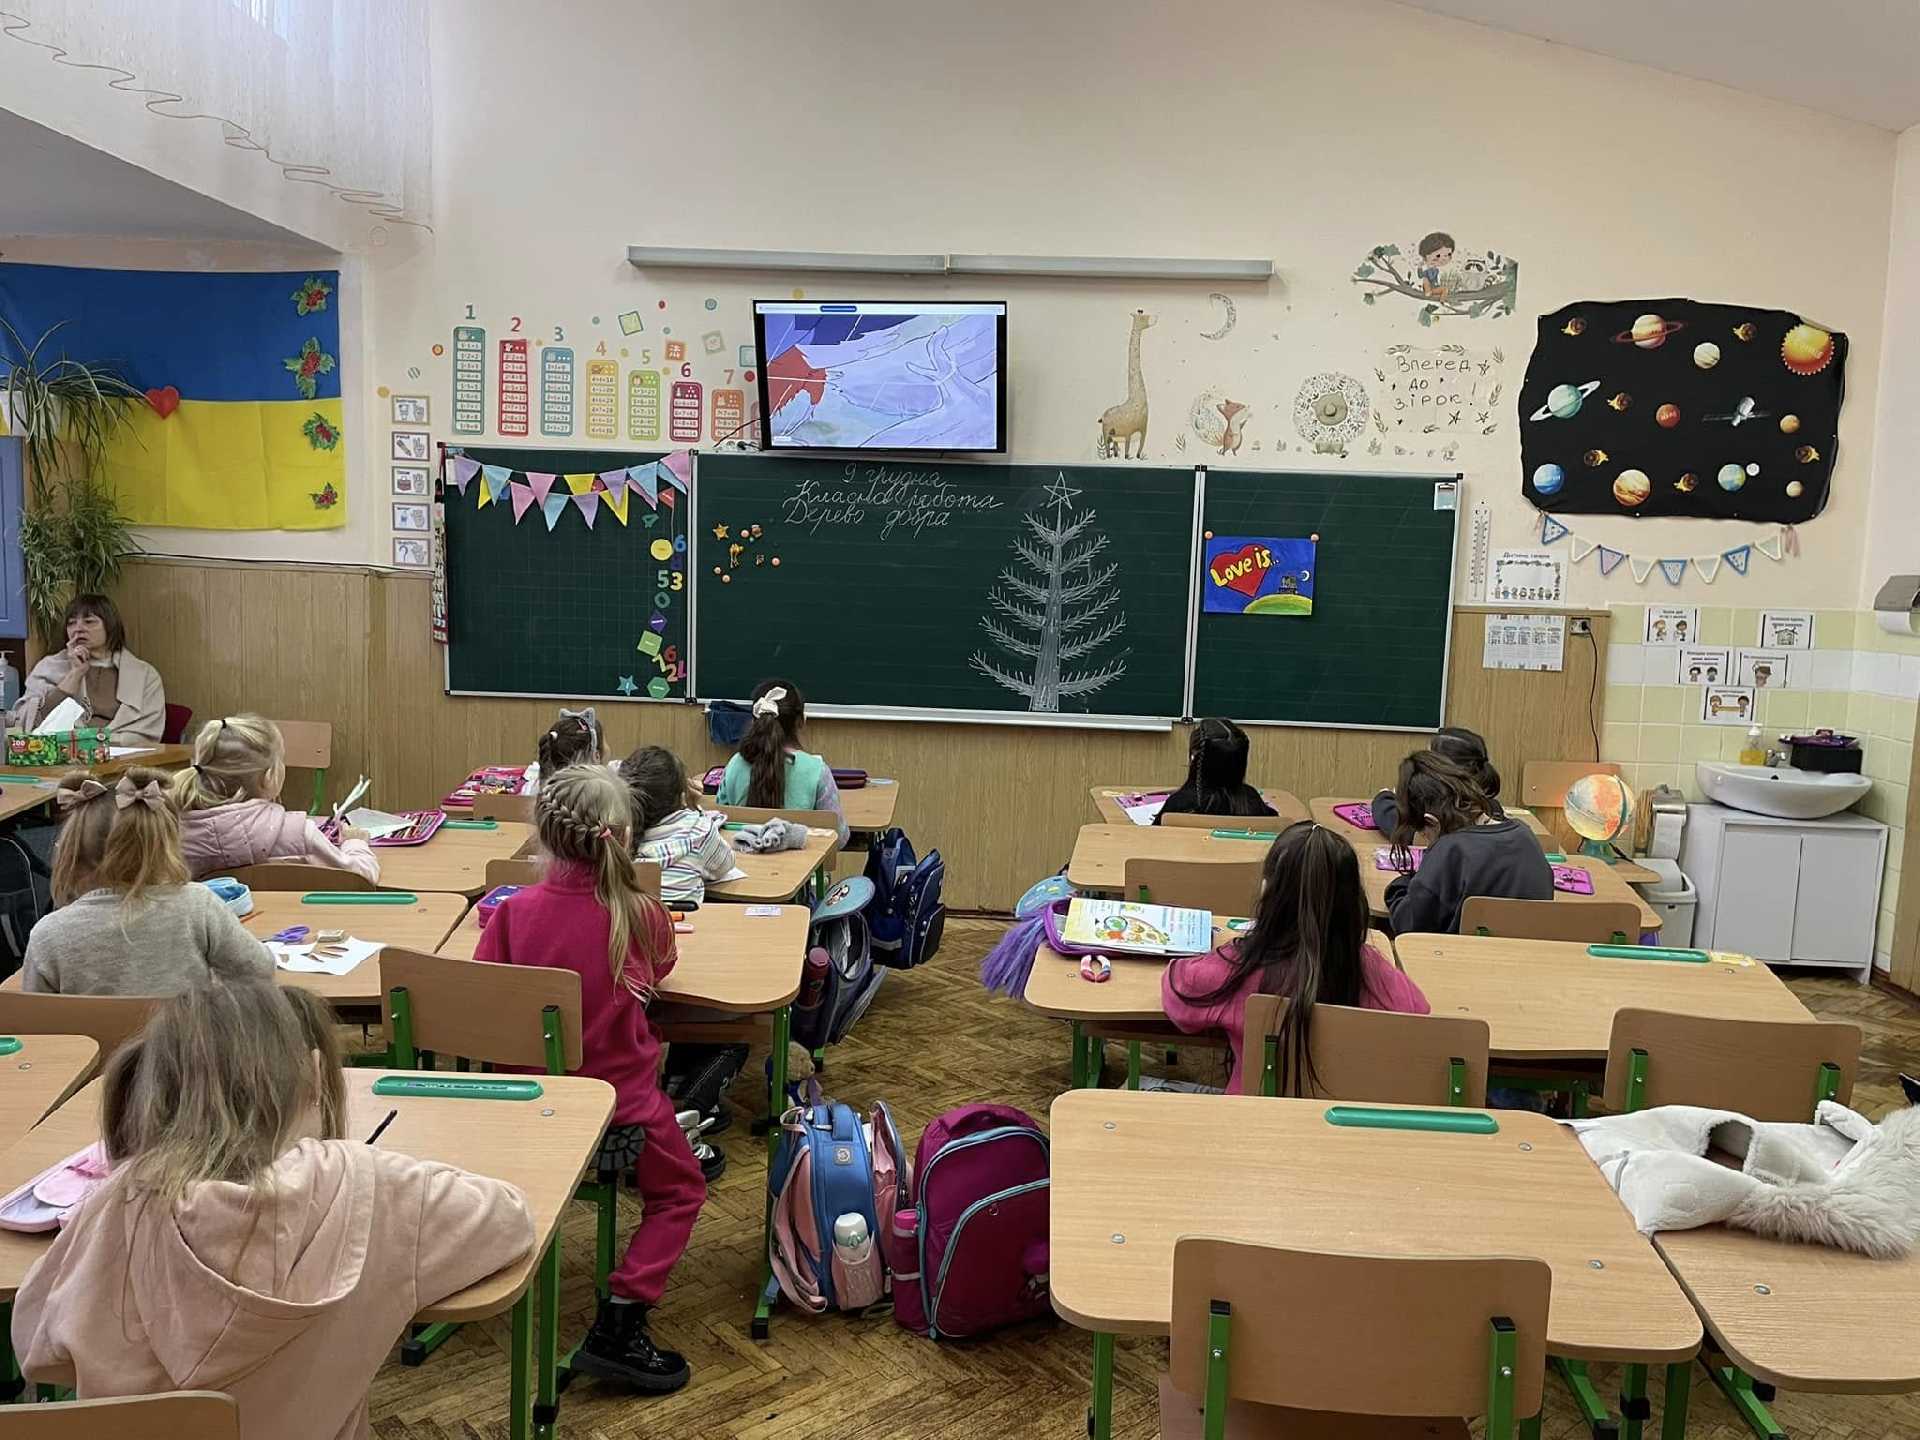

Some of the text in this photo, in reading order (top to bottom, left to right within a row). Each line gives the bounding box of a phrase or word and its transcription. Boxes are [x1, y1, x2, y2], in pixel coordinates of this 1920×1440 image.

[465, 304, 476, 320] 1
[510, 317, 521, 333] 2
[554, 326, 564, 342] 3
[595, 341, 607, 356] 4
[641, 349, 651, 365] 5
[1396, 355, 1471, 374] Вперед
[680, 362, 691, 378] 6
[723, 369, 734, 385] 7
[784, 499, 950, 540] Дерево добра
[674, 534, 686, 552] 6
[657, 569, 683, 591] 5 3
[1210, 558, 1252, 586] Love
